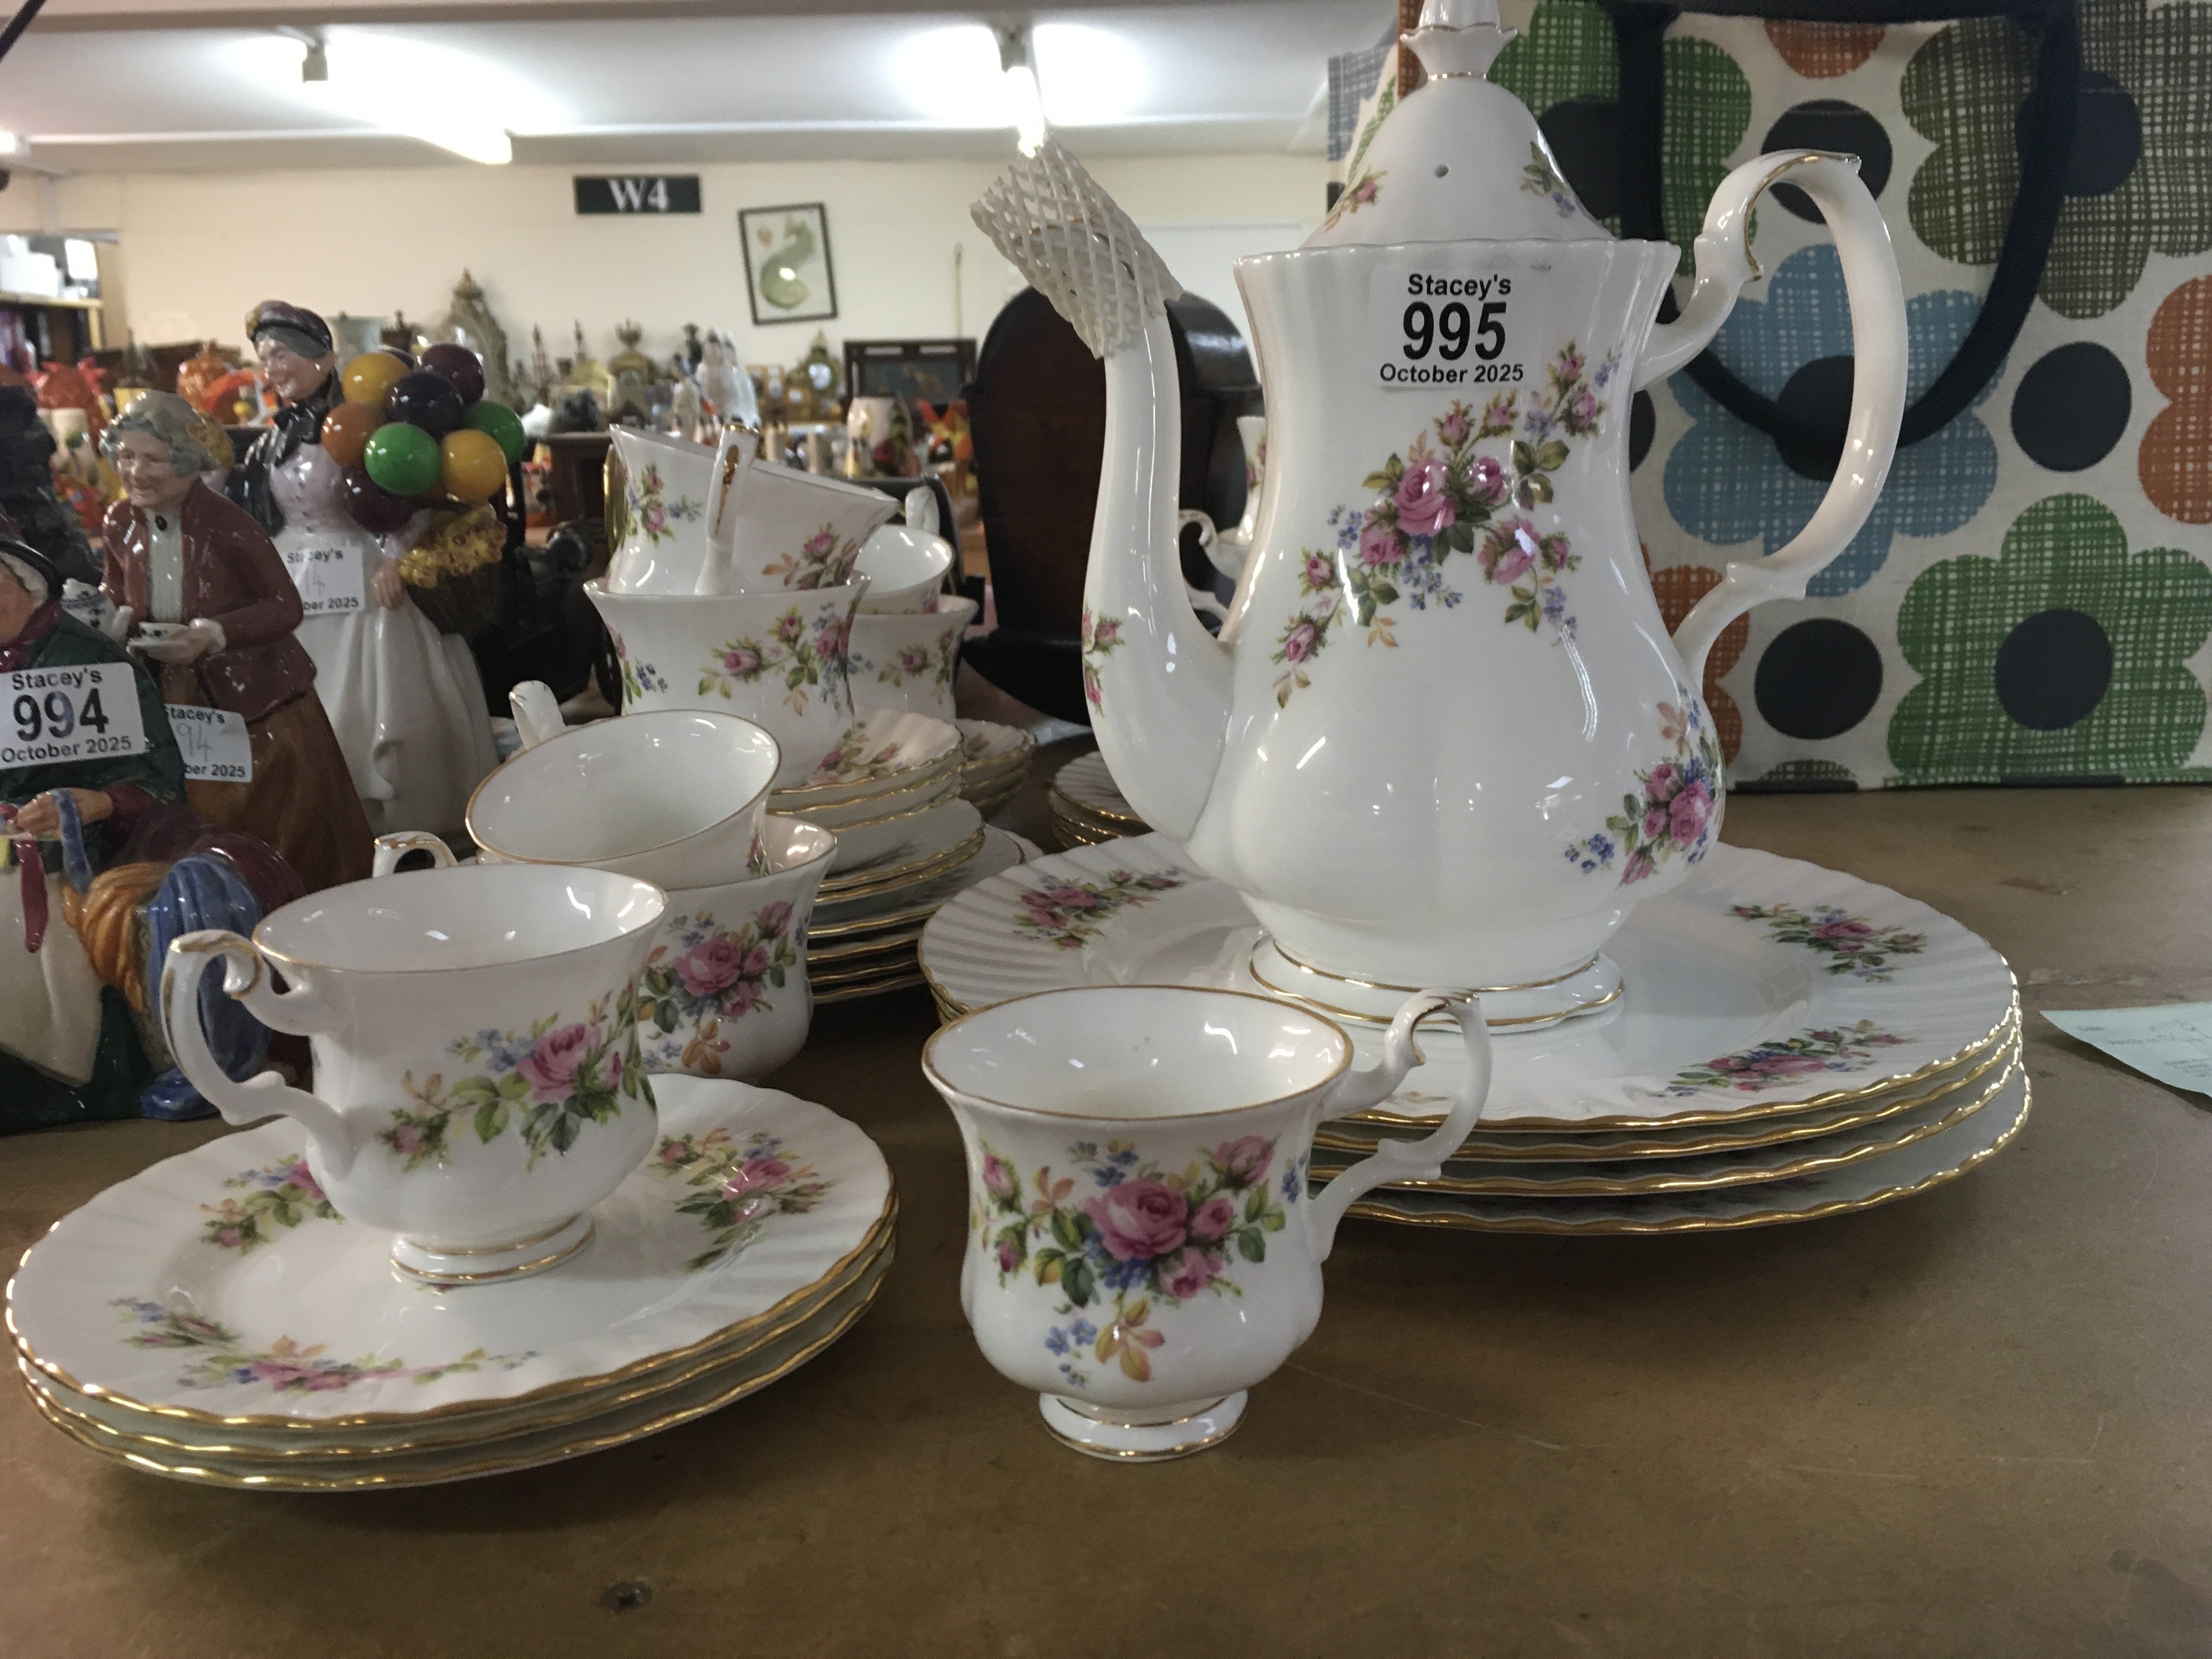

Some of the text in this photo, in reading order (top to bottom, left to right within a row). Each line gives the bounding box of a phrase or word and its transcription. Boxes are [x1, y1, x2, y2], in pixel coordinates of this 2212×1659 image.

[608, 178, 668, 211] W4
[1408, 273, 1512, 301] Stacey's
[1403, 301, 1507, 360] 995
[1380, 363, 1524, 383] October 2025
[328, 597, 358, 608] 2025
[12, 668, 103, 690] Stacey's
[13, 688, 108, 741] 994
[1, 736, 132, 763] October 2025
[211, 764, 245, 777] 2025
